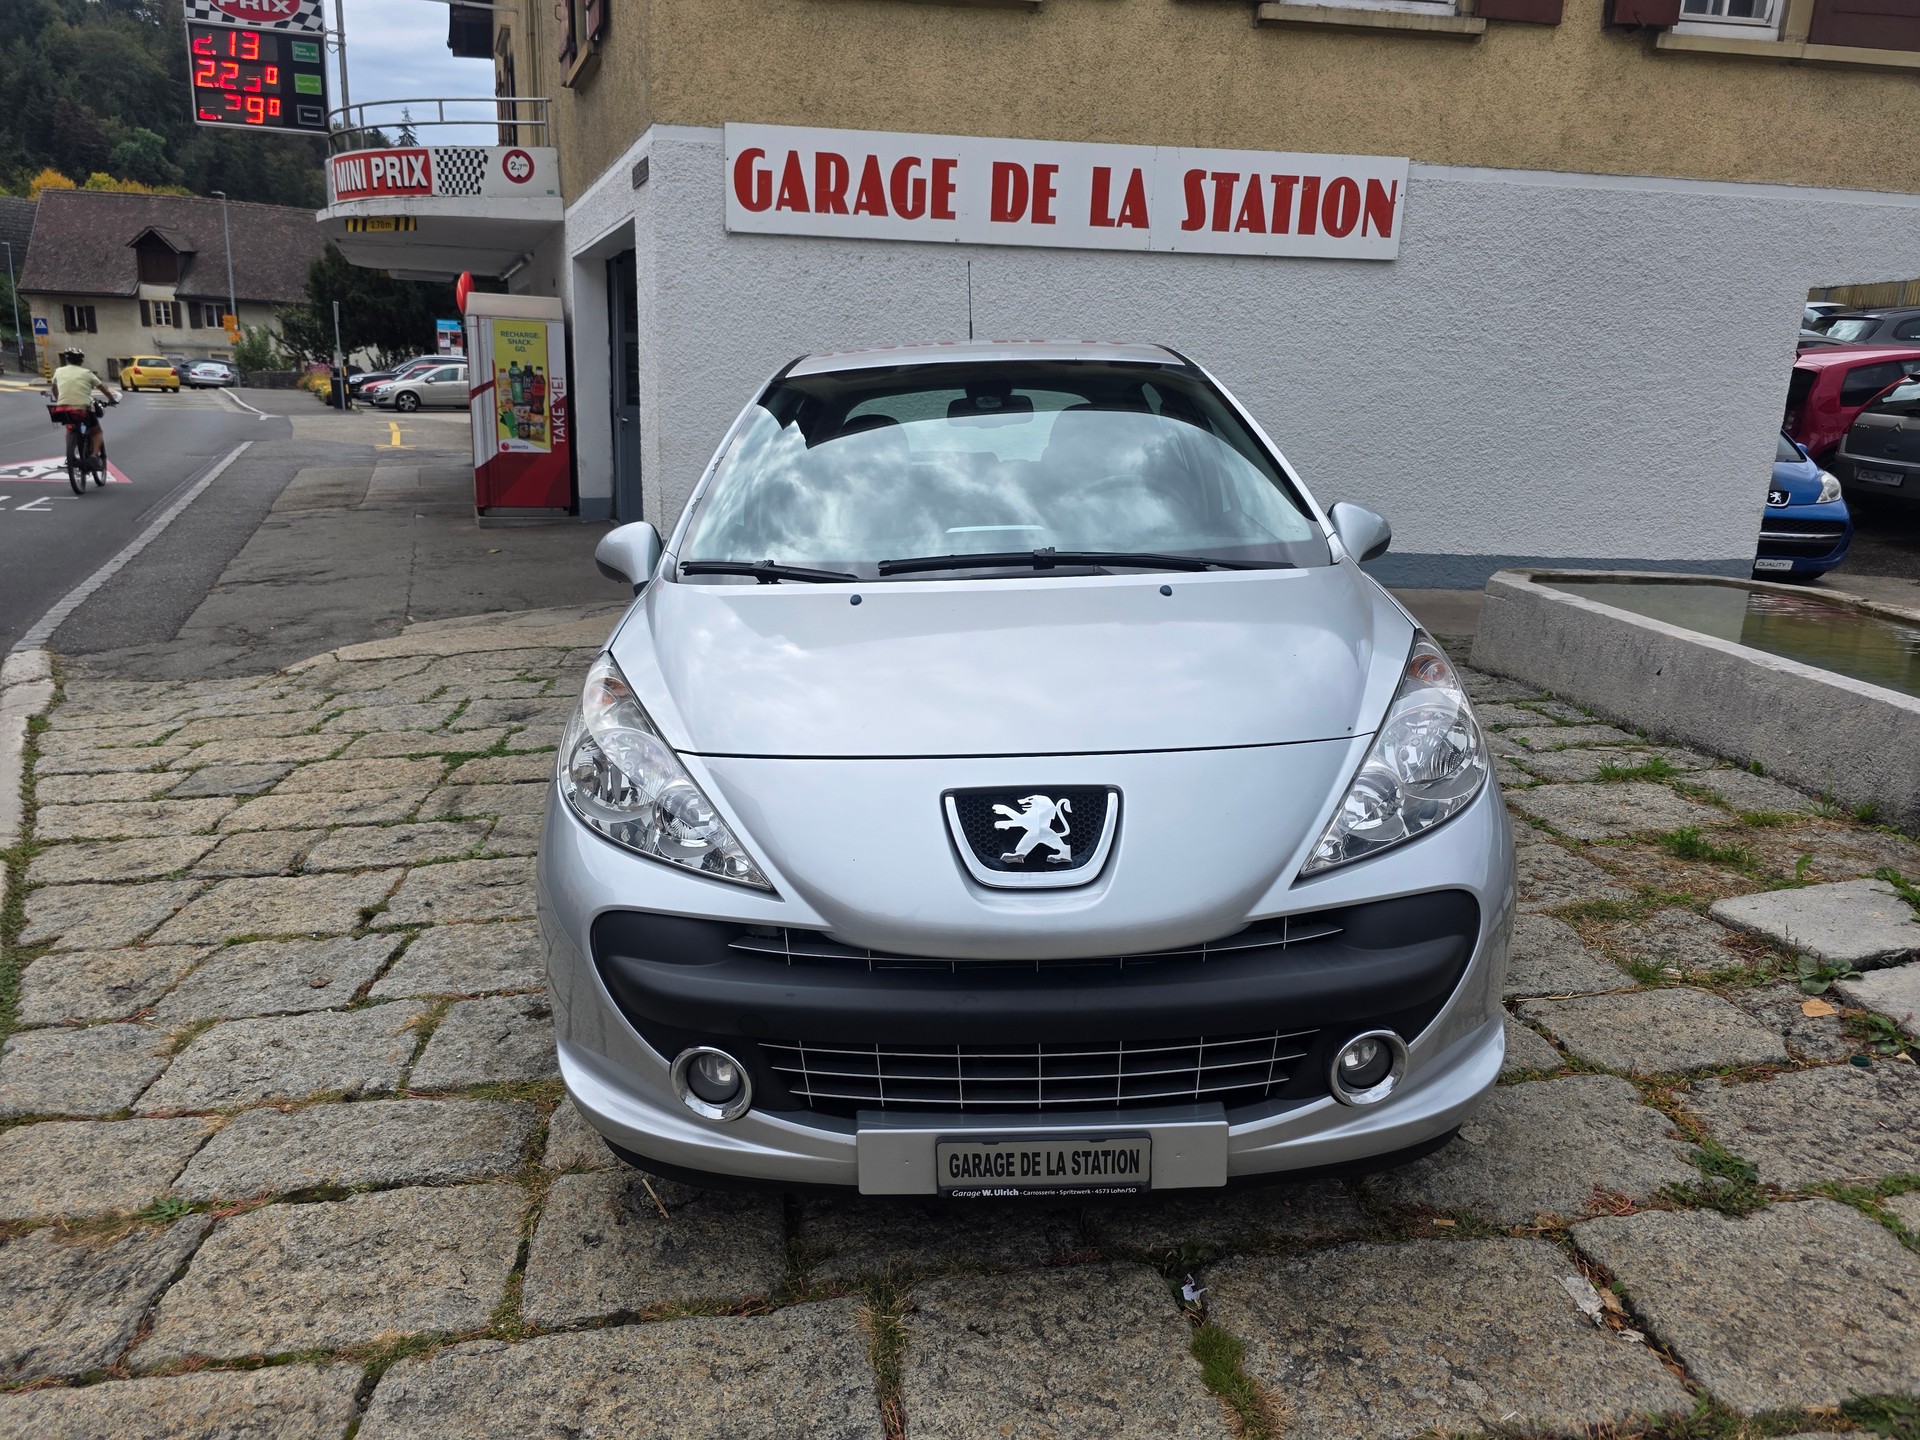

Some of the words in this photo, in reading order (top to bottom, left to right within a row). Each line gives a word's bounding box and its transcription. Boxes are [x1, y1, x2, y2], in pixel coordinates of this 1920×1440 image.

[336, 158, 367, 193] MINI
[370, 155, 428, 189] PRIX
[733, 147, 958, 221] GARAGE
[990, 161, 1060, 225] DE
[1089, 166, 1150, 229] LA
[1180, 168, 1398, 239] STATION
[551, 377, 563, 404] ME!
[552, 407, 566, 445] TAKE
[949, 1152, 1016, 1179] GARAGE
[1020, 1151, 1041, 1177] DE
[1046, 1151, 1067, 1176] LA
[1071, 1149, 1140, 1176] STATION
[951, 1189, 981, 1199] Garage
[994, 1188, 1019, 1196] Ulrich
[1059, 1188, 1091, 1196] Spritzwerk
